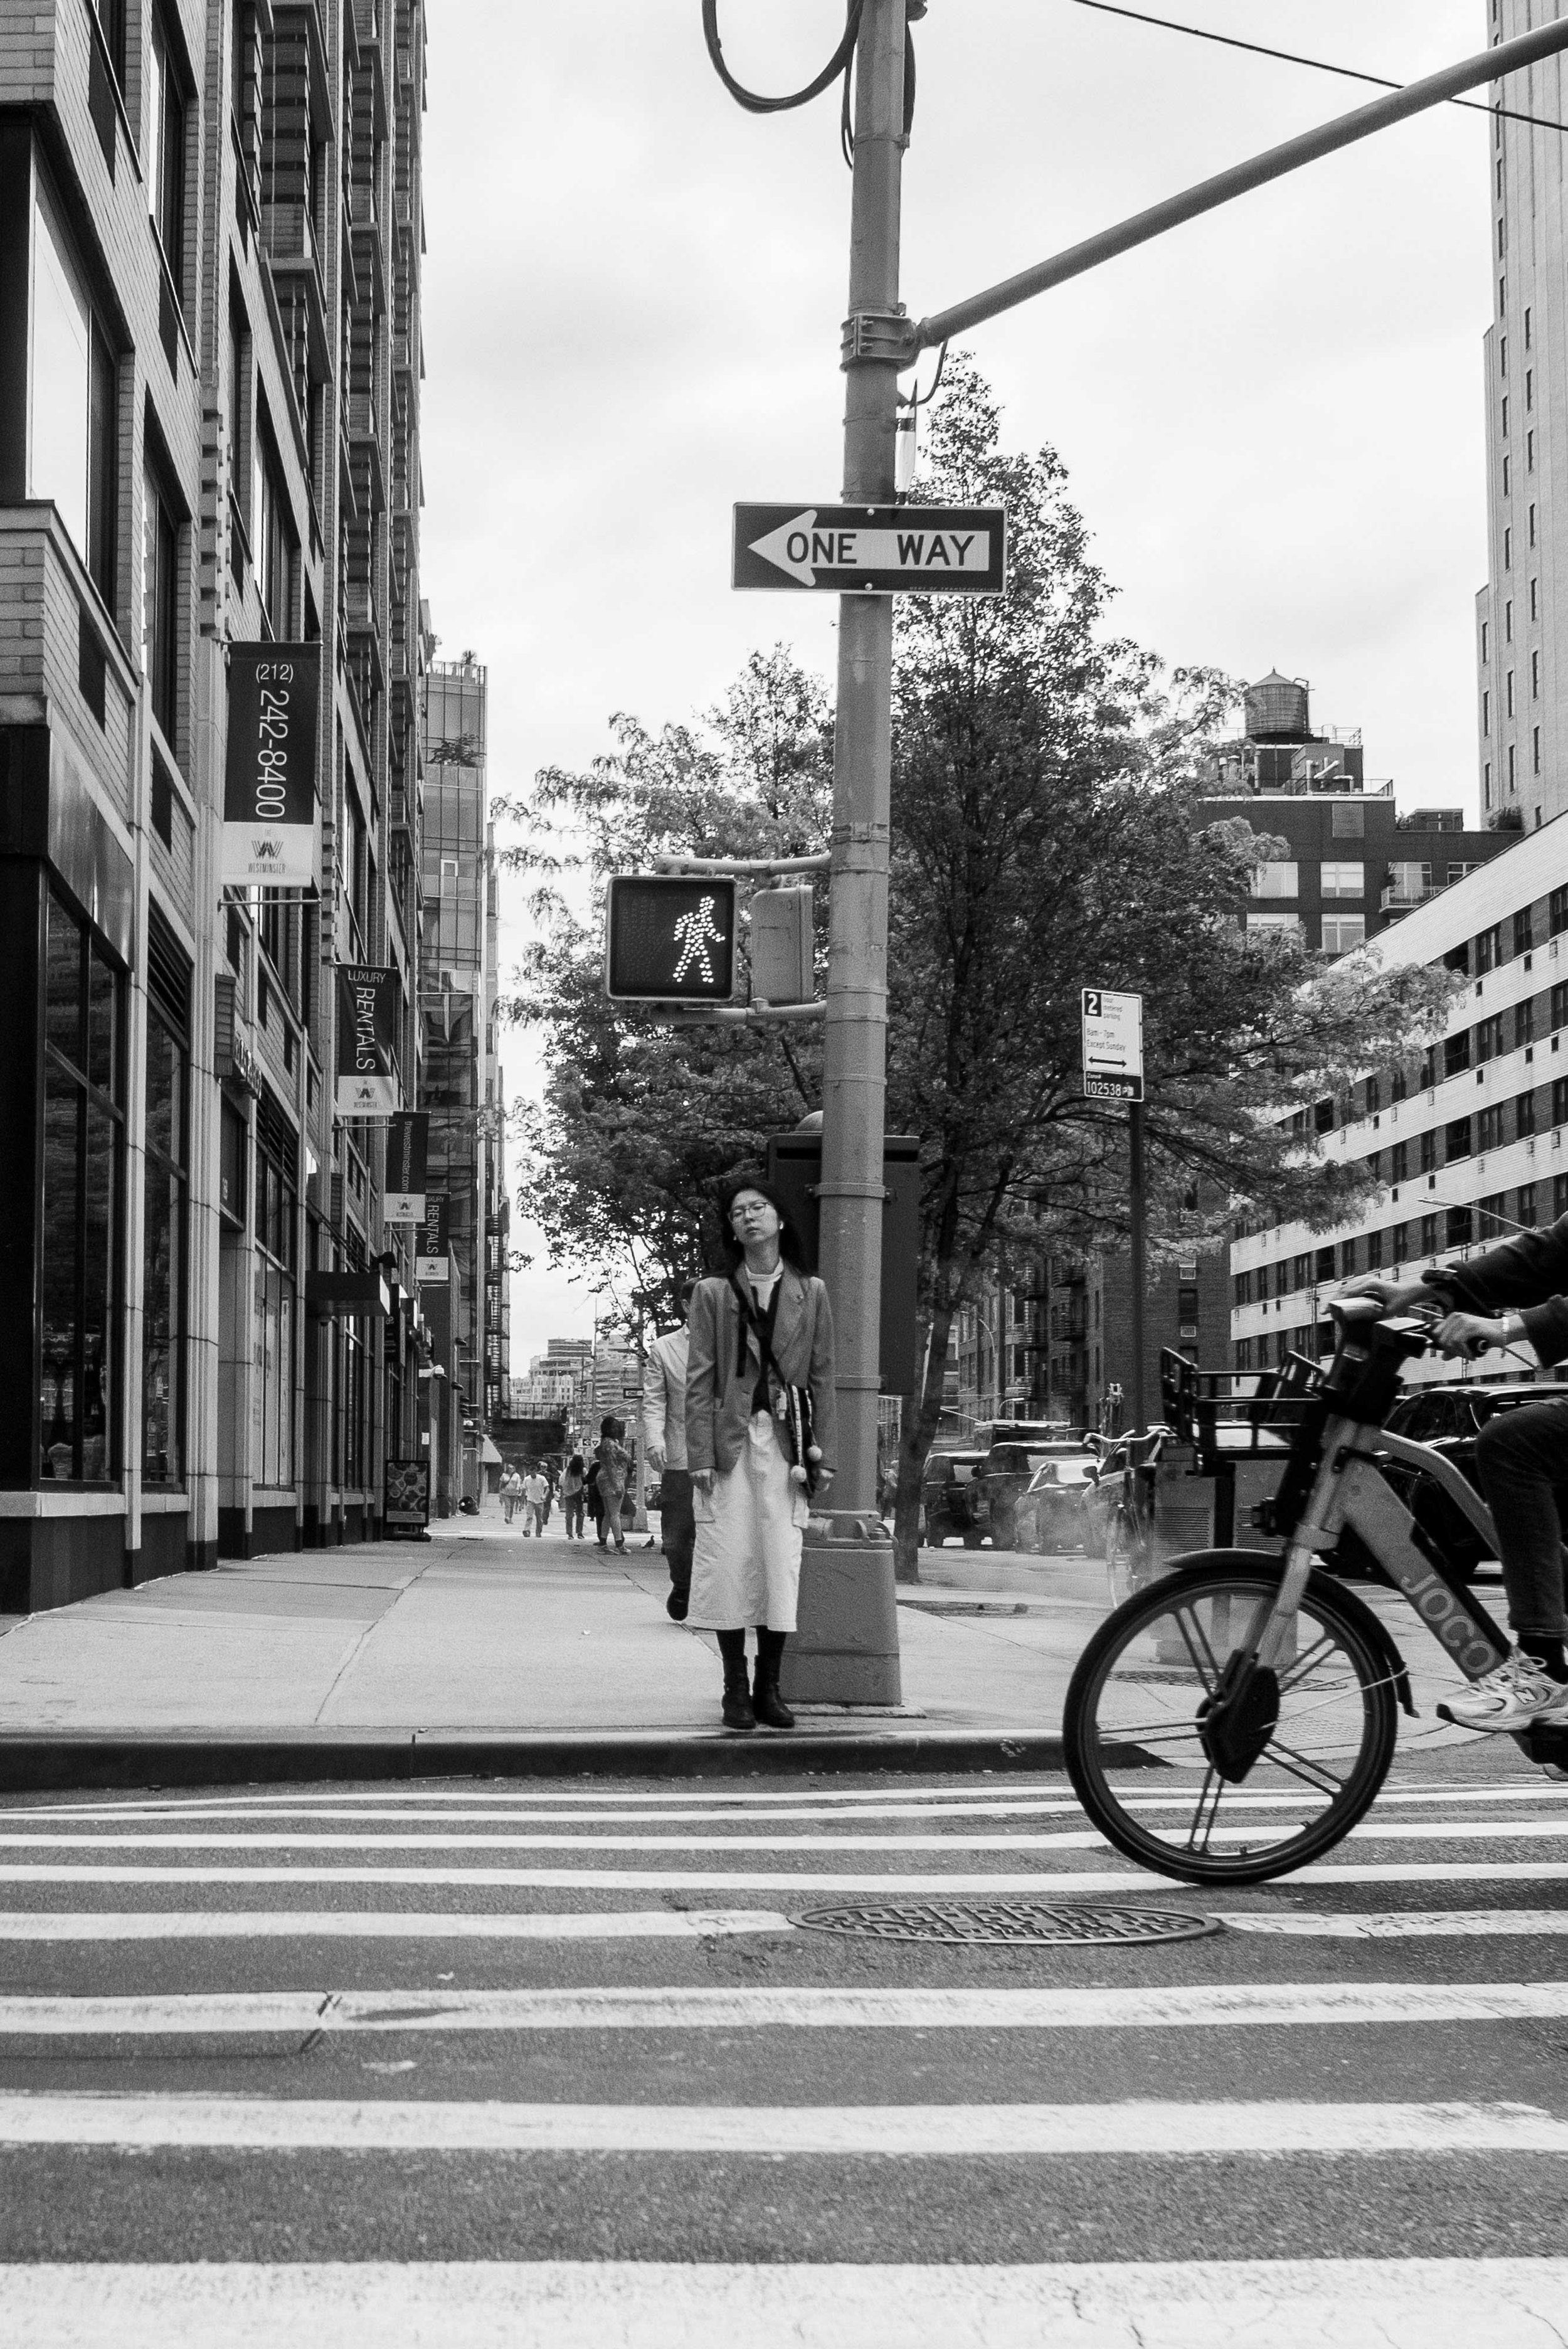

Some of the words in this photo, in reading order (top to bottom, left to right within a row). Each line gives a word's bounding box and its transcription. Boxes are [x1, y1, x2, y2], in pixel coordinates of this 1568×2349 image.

[786, 531, 857, 565] ONE
[897, 534, 975, 566] WAY
[255, 663, 294, 683] (212)
[255, 690, 290, 819] 242-8400
[248, 862, 286, 874] WESTMINSTER
[348, 970, 386, 985] LUXURY
[1088, 993, 1098, 1015] 2
[356, 986, 376, 1071] RENTALS
[1086, 1039, 1105, 1051] Except
[1106, 1041, 1126, 1053] Sunday
[1086, 1081, 1121, 1097] 102538
[401, 1121, 413, 1192] thewestminster.com
[426, 1205, 440, 1254] RENTALS
[1399, 1572, 1496, 1674] JOCO
